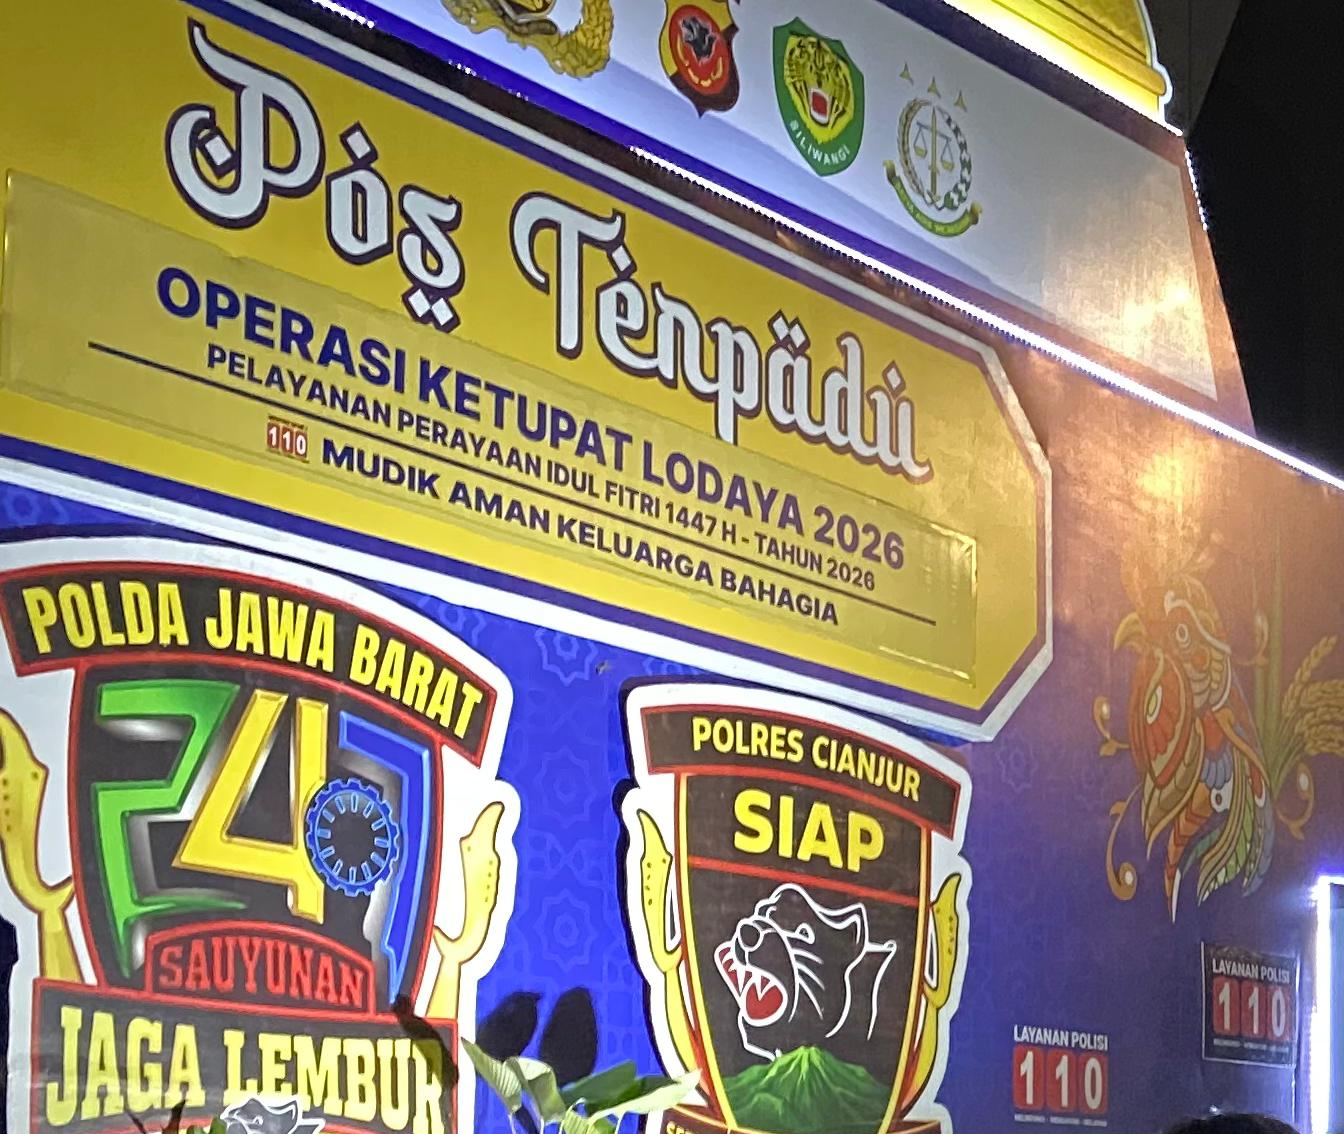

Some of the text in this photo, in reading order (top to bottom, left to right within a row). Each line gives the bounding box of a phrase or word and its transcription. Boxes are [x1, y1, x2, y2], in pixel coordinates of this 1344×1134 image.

[157, 267, 905, 571] OPERASI KETUPAT LODAYA 2026
[207, 342, 391, 429] PELAYANAN
[398, 408, 541, 478] PERAYAAN
[547, 459, 599, 498] IDUL
[605, 480, 660, 519] FITRI
[665, 502, 716, 538] 1447
[721, 519, 736, 545] H
[754, 532, 822, 574] TAHUN
[826, 557, 875, 592] 2026
[268, 425, 839, 626] 110 MUDIK AMAN KELUARGA BAHAGIA
[22, 580, 483, 740] POLDA JAWA BARAT
[692, 716, 922, 802] POLRES CIANJUR
[733, 789, 885, 873] SIAP
[158, 935, 366, 1009] SAUYUNAN
[1212, 958, 1290, 983] LAYANAN POLISI
[1218, 982, 1287, 1037] 110
[46, 1005, 206, 1127] JAGA
[1013, 1024, 1109, 1051] LAYANAN POLISI
[1020, 1050, 1102, 1110] 110
